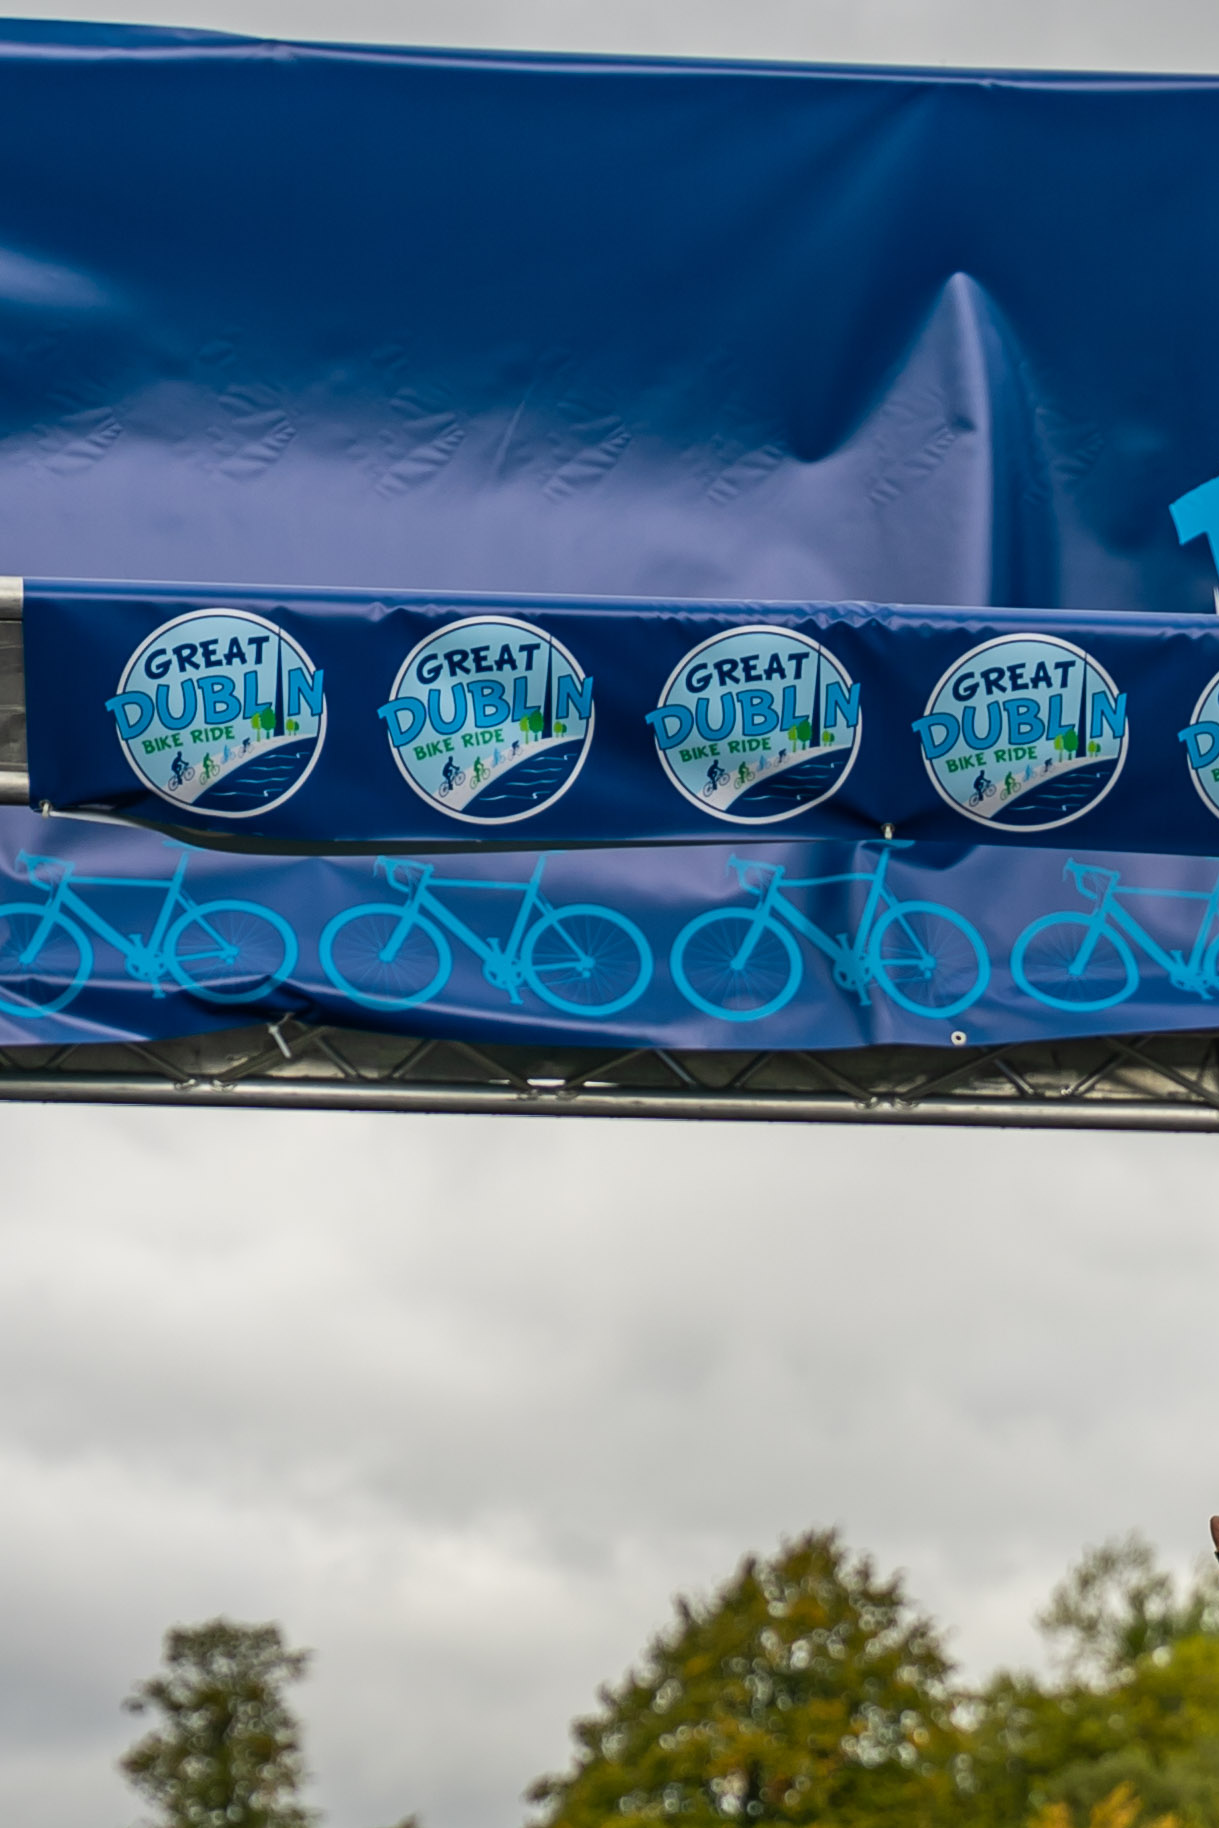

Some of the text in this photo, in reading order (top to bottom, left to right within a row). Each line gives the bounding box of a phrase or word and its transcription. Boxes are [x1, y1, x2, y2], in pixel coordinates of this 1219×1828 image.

[143, 635, 270, 681] GREAT
[416, 644, 541, 686] GREAT
[685, 651, 810, 694] GREAT
[951, 660, 1077, 701] GREAT
[142, 725, 235, 755] BIKE RIDE
[413, 730, 505, 761] BIKE RIDE
[679, 736, 772, 763] BIKE RIDE
[946, 745, 1038, 774] BIKE RIDE
